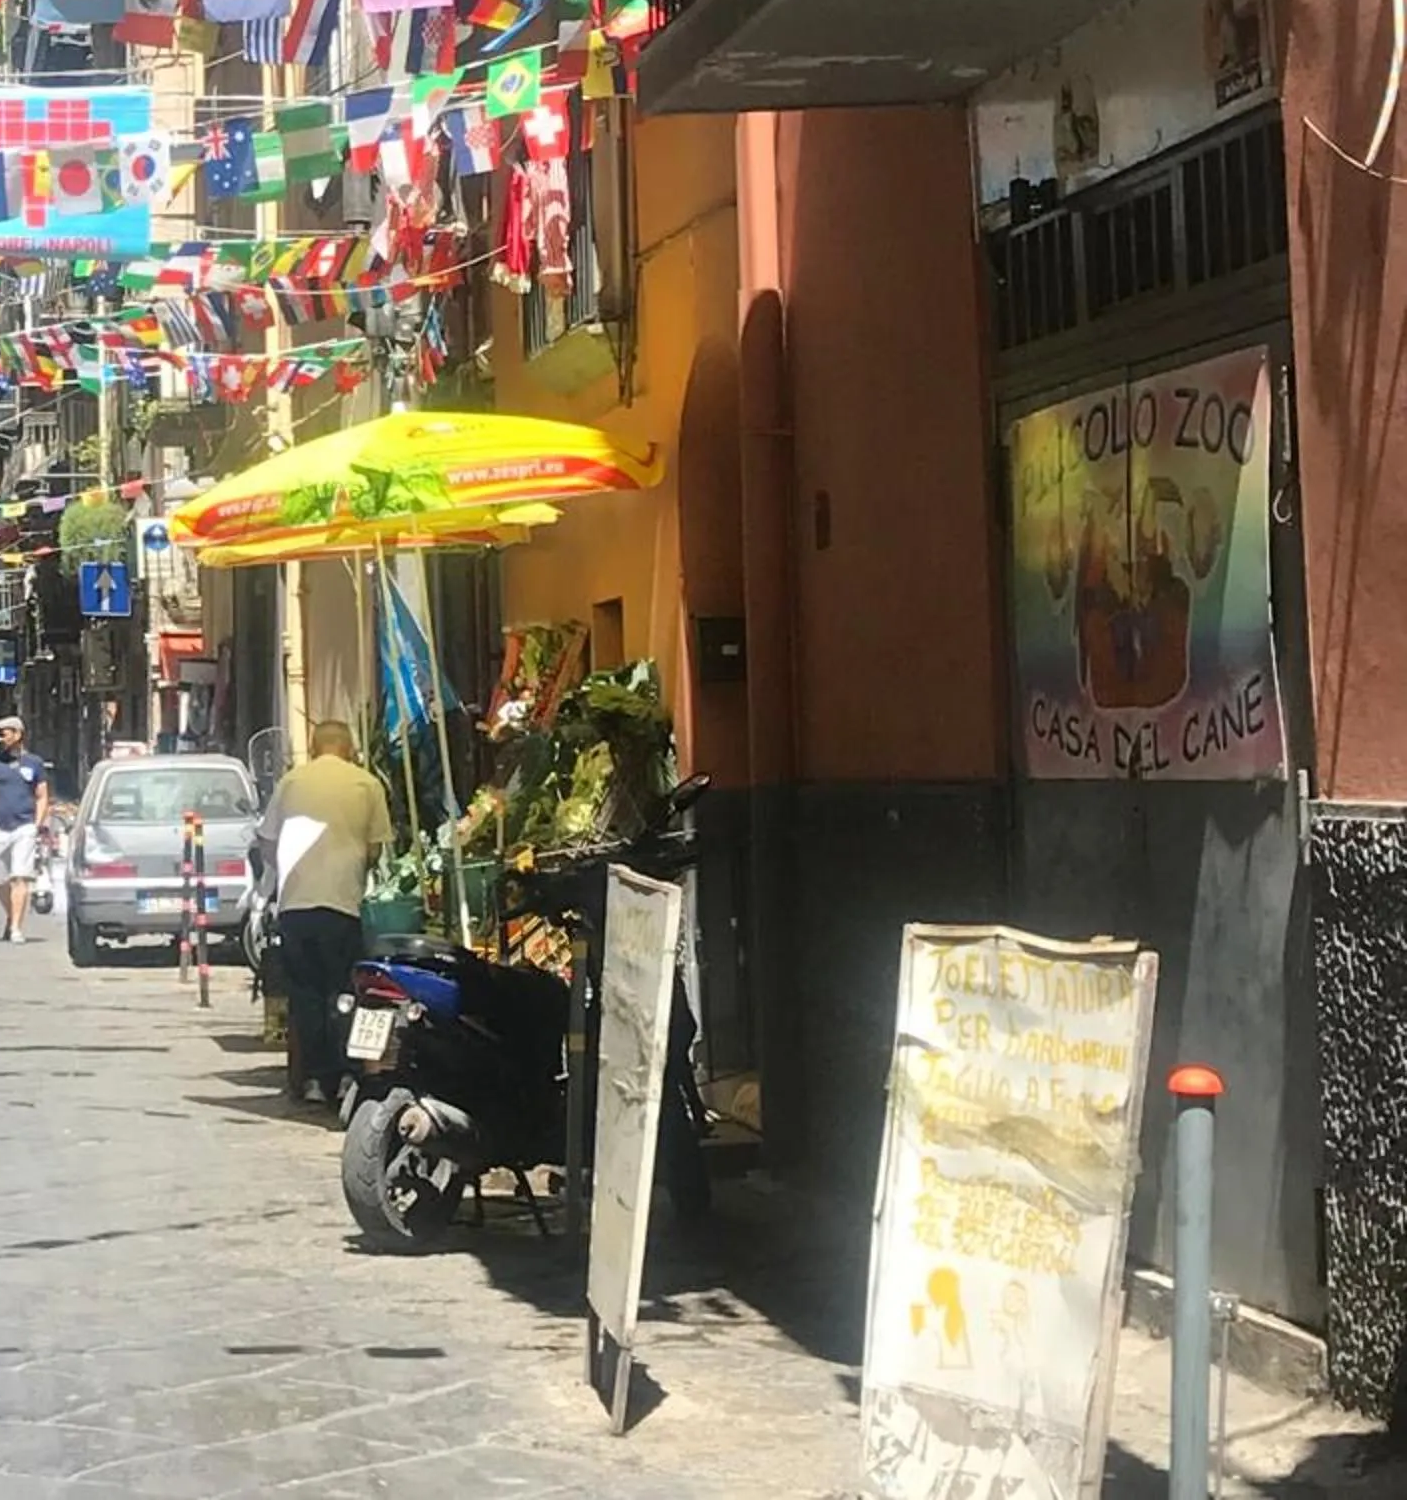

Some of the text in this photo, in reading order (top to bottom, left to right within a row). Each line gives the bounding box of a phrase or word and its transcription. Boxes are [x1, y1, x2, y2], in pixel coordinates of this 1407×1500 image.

[1173, 387, 1255, 466] ZOO
[1032, 673, 1265, 772] CASA DEL CANE
[934, 998, 991, 1052] PER
